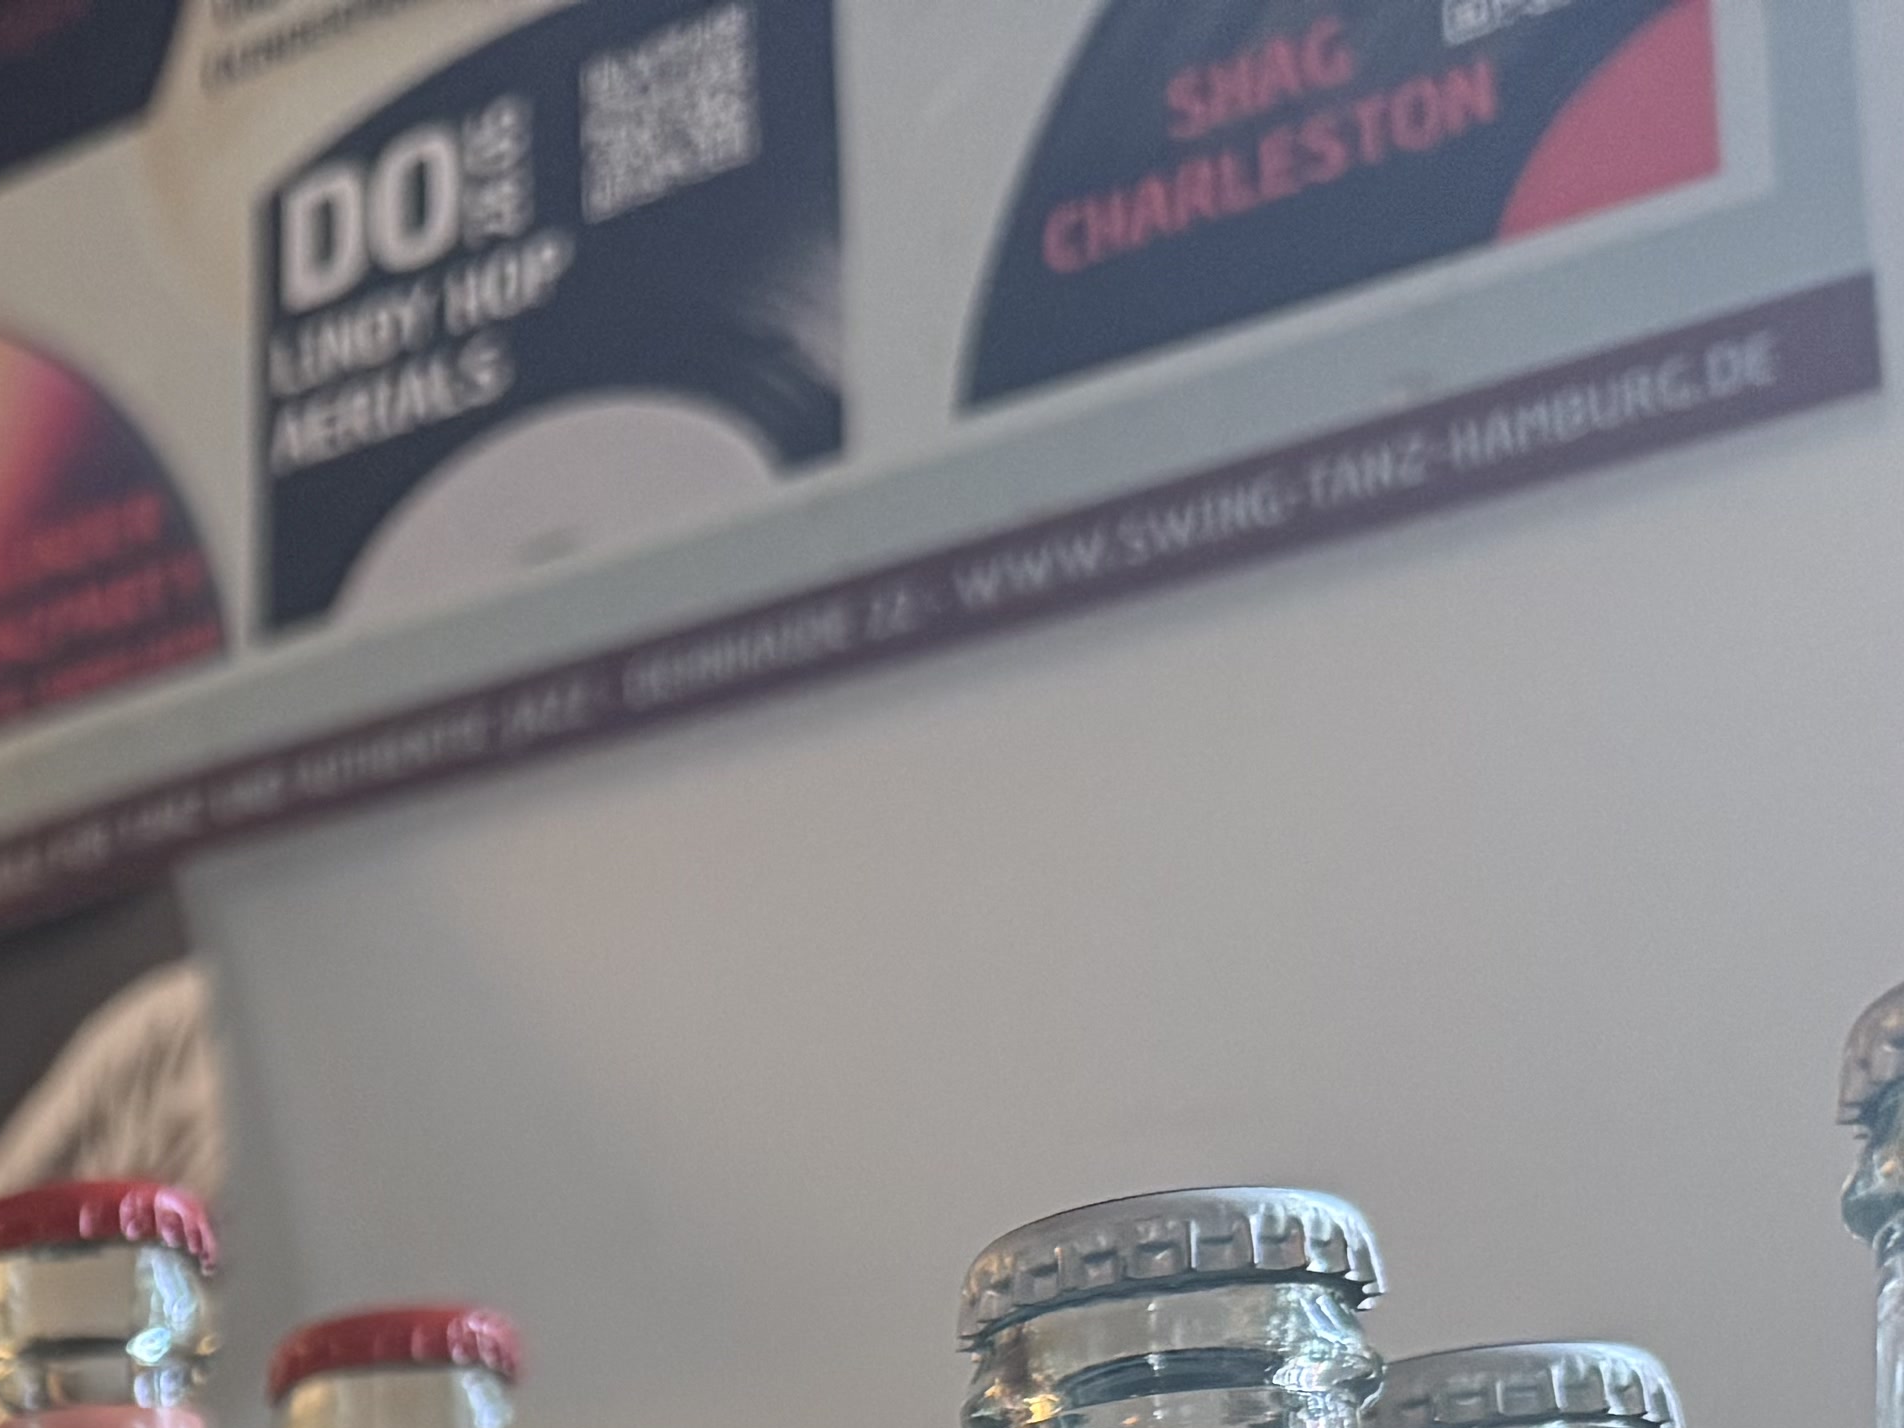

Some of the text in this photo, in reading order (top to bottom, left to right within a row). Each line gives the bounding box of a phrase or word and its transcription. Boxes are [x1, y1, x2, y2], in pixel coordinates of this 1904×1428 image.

[1040, 57, 1502, 276] CHARLESTON
[1165, 14, 1355, 142] SHAG
[277, 122, 459, 318] DO
